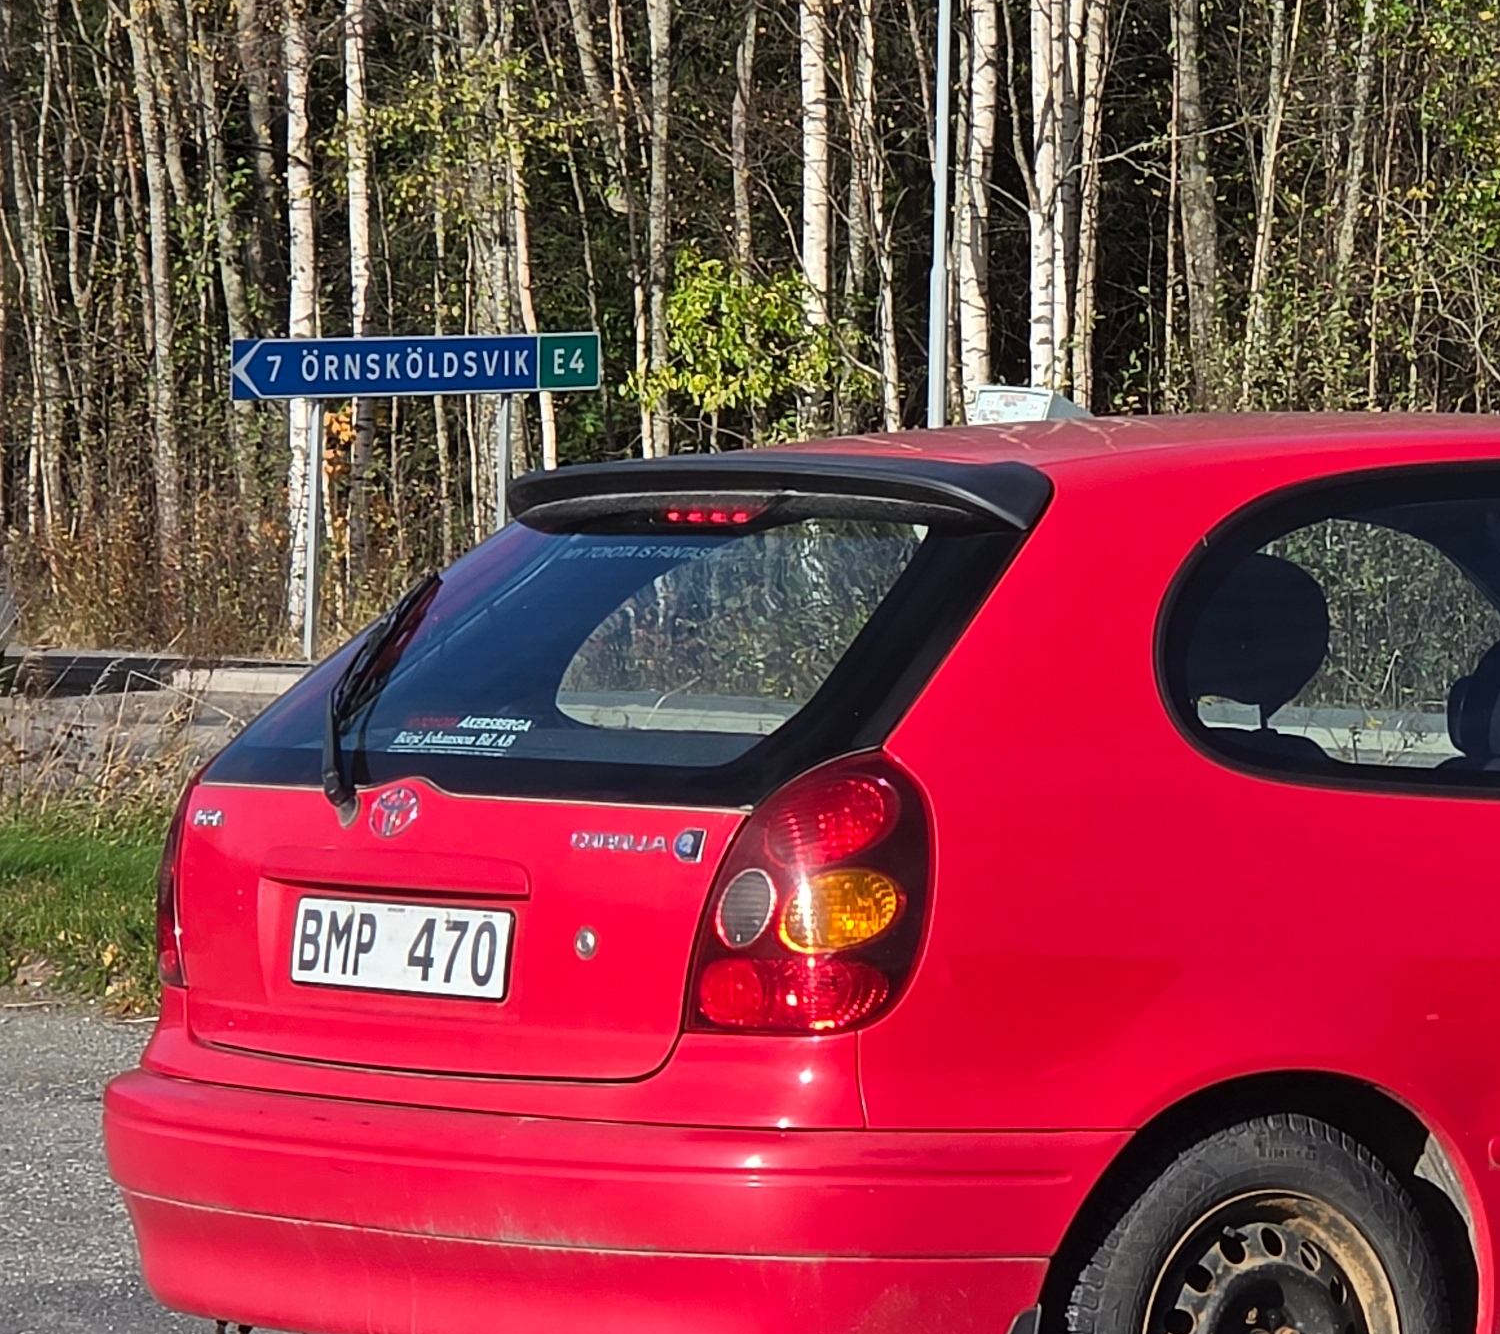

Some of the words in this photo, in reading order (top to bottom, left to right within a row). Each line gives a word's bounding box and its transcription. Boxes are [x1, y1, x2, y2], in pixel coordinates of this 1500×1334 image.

[266, 355, 282, 382] 7
[301, 346, 530, 382] ÖRNSKÖLDSVIK
[553, 348, 585, 375] E4
[585, 546, 640, 559] TOYOTA
[493, 734, 516, 748] AB
[298, 909, 377, 976] BMP
[407, 918, 497, 986] 470
